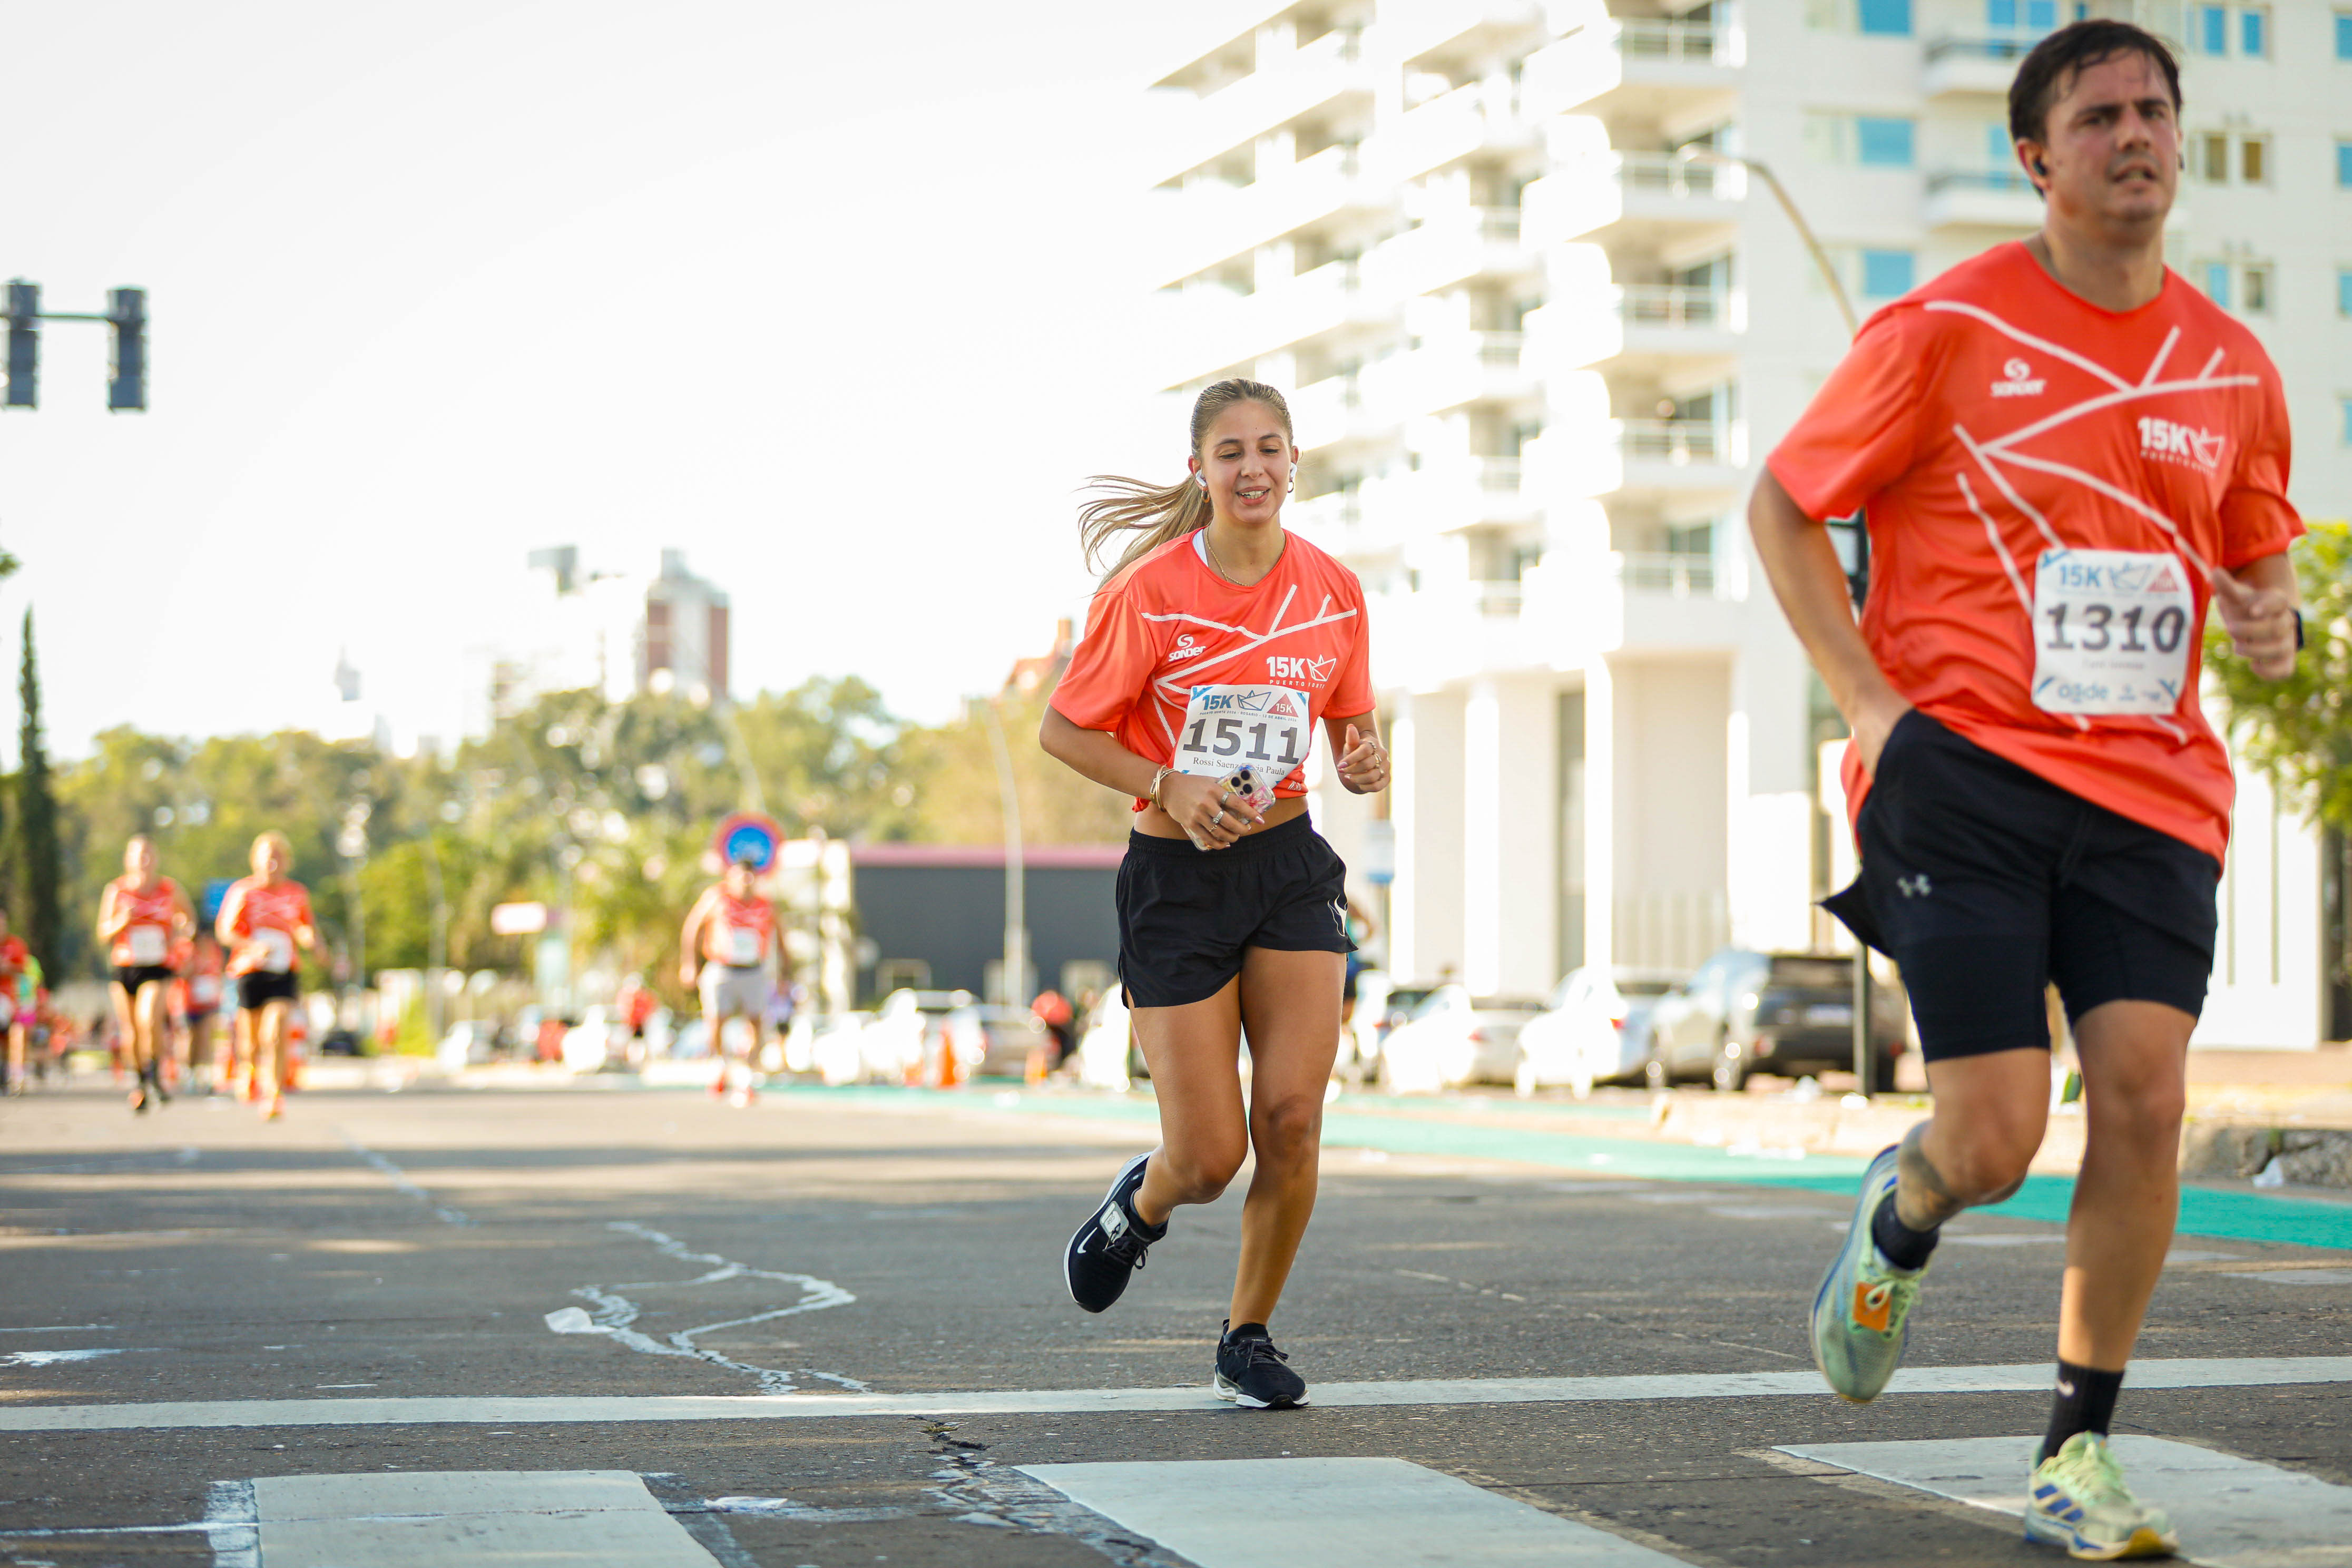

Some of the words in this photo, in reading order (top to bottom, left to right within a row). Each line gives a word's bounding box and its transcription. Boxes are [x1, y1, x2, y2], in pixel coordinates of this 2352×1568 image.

[2138, 417, 2190, 457] 15K
[2059, 564, 2103, 588] 15K
[2046, 603, 2186, 654] 1310
[1266, 656, 1306, 679] 15K
[1202, 694, 1235, 711] 15K
[1276, 702, 1293, 714] 15K
[1183, 718, 1299, 764] 1511
[1193, 757, 1214, 766] Rossi
[1216, 759, 1239, 769] Saenz
